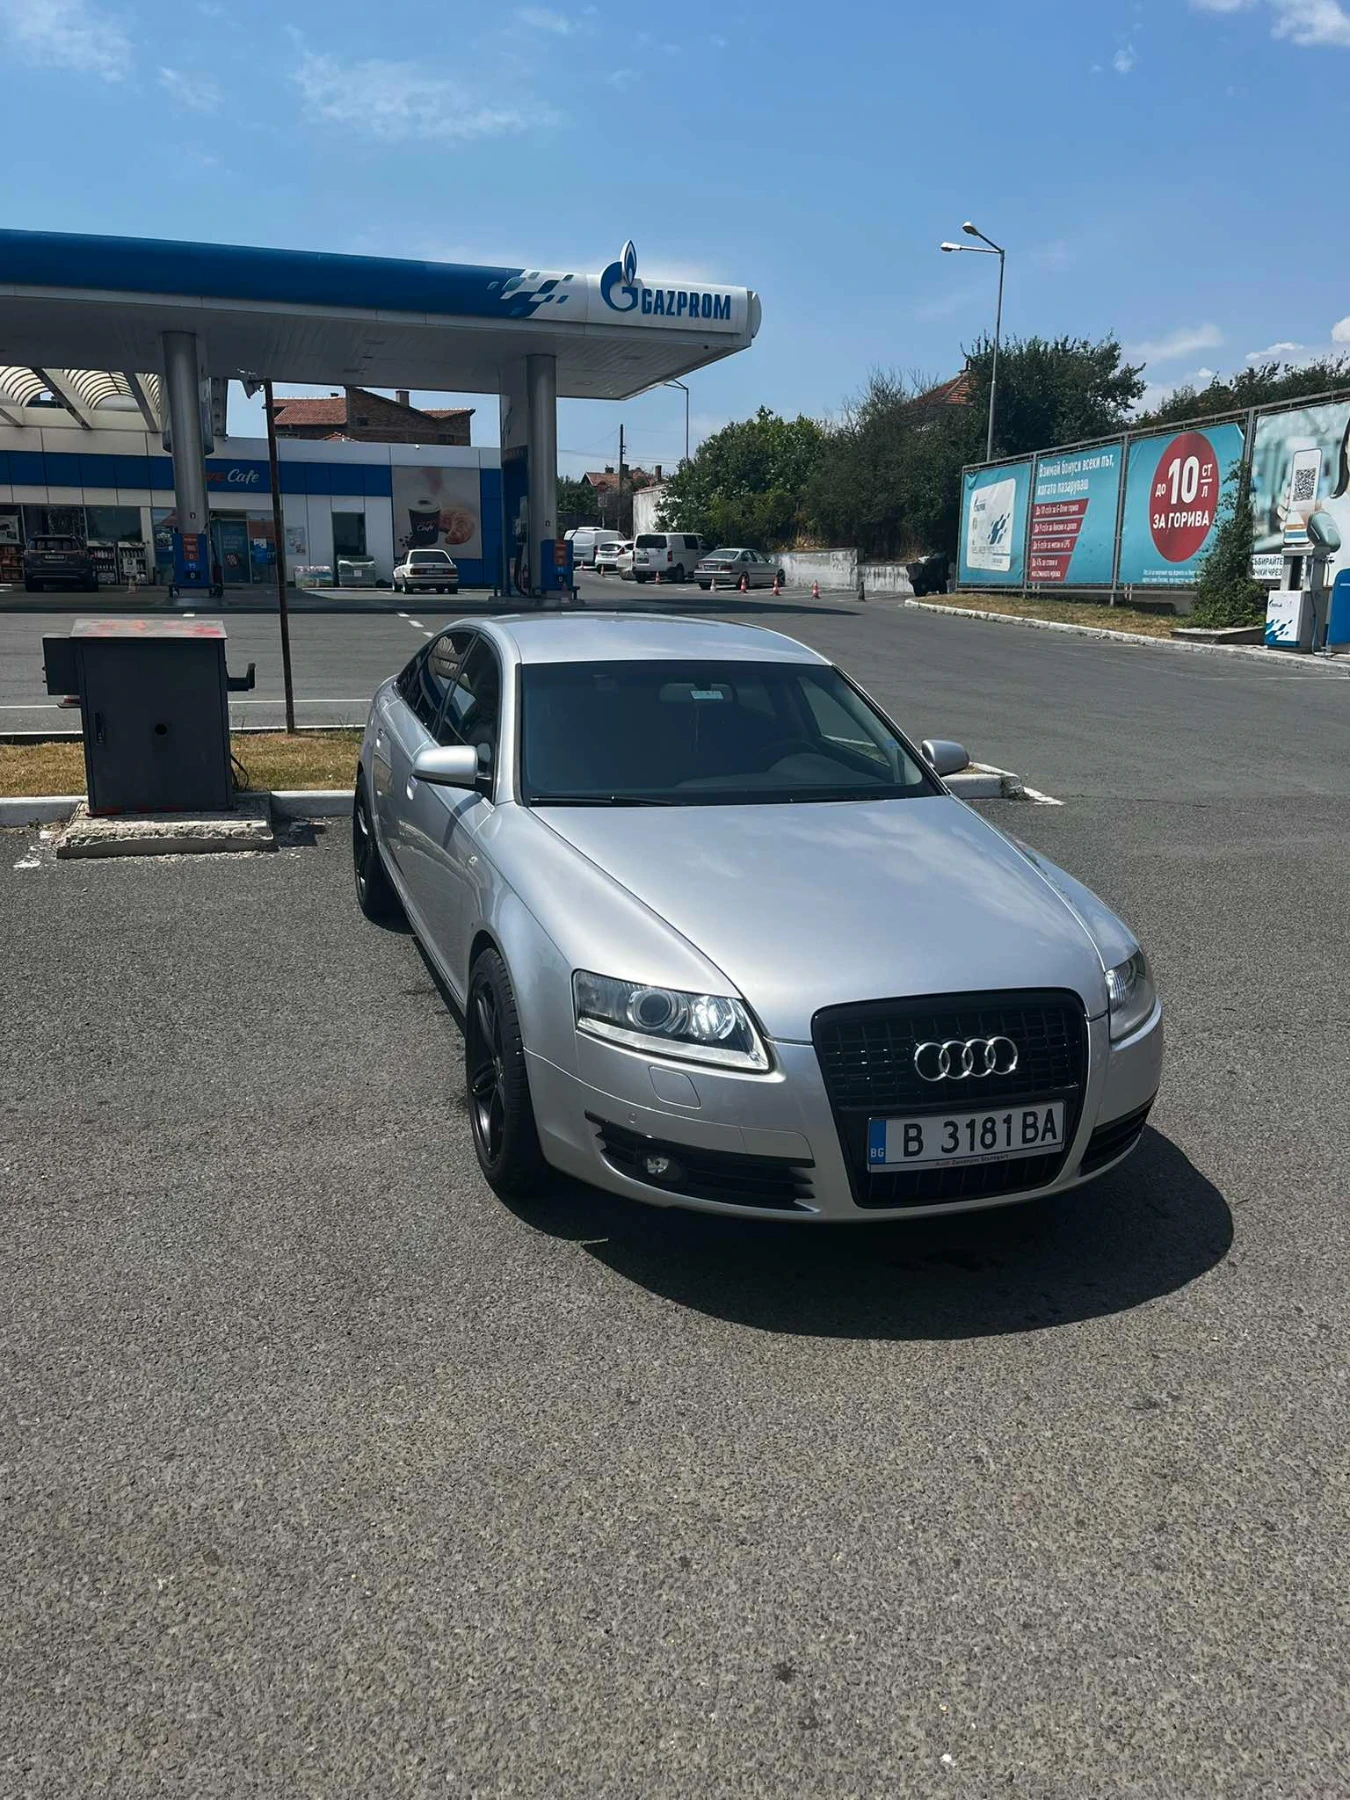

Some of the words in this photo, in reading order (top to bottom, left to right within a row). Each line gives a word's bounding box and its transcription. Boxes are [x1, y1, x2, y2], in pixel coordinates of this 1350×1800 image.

[641, 288, 731, 320] GAZPROM
[1082, 457, 1100, 471] всеки
[1202, 463, 1213, 477] СТ
[1155, 483, 1166, 498] ДО
[1168, 455, 1200, 505] 10
[1201, 485, 1209, 498] Л
[1152, 513, 1166, 529] ЗА
[1168, 510, 1210, 528] ГОРИВА
[903, 1122, 924, 1157] B
[941, 1113, 1013, 1154] 3181
[1021, 1108, 1057, 1144] BA
[870, 1147, 884, 1158] BG
